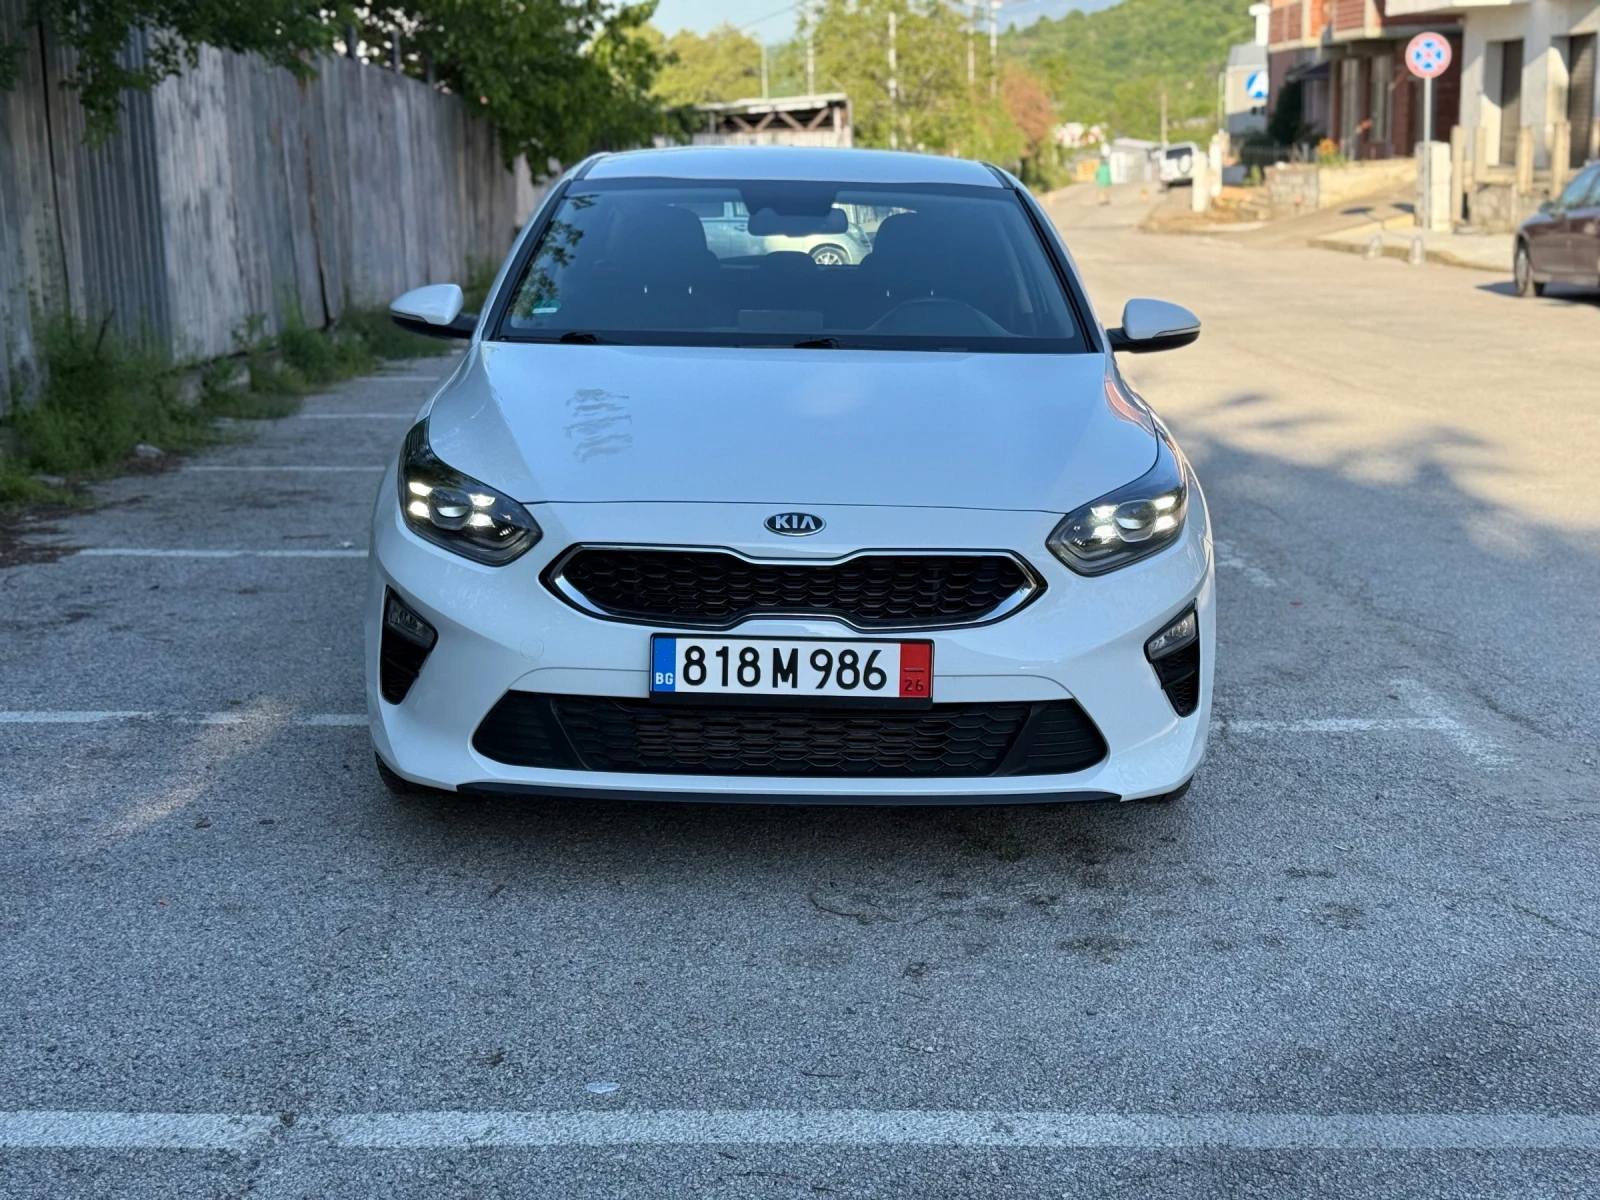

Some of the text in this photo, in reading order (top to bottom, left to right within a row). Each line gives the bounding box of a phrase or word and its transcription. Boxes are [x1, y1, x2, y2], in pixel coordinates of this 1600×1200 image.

[775, 515, 816, 529] KIA
[683, 645, 888, 691] 818 M 986
[655, 671, 674, 685] BG
[904, 677, 924, 692] 26
